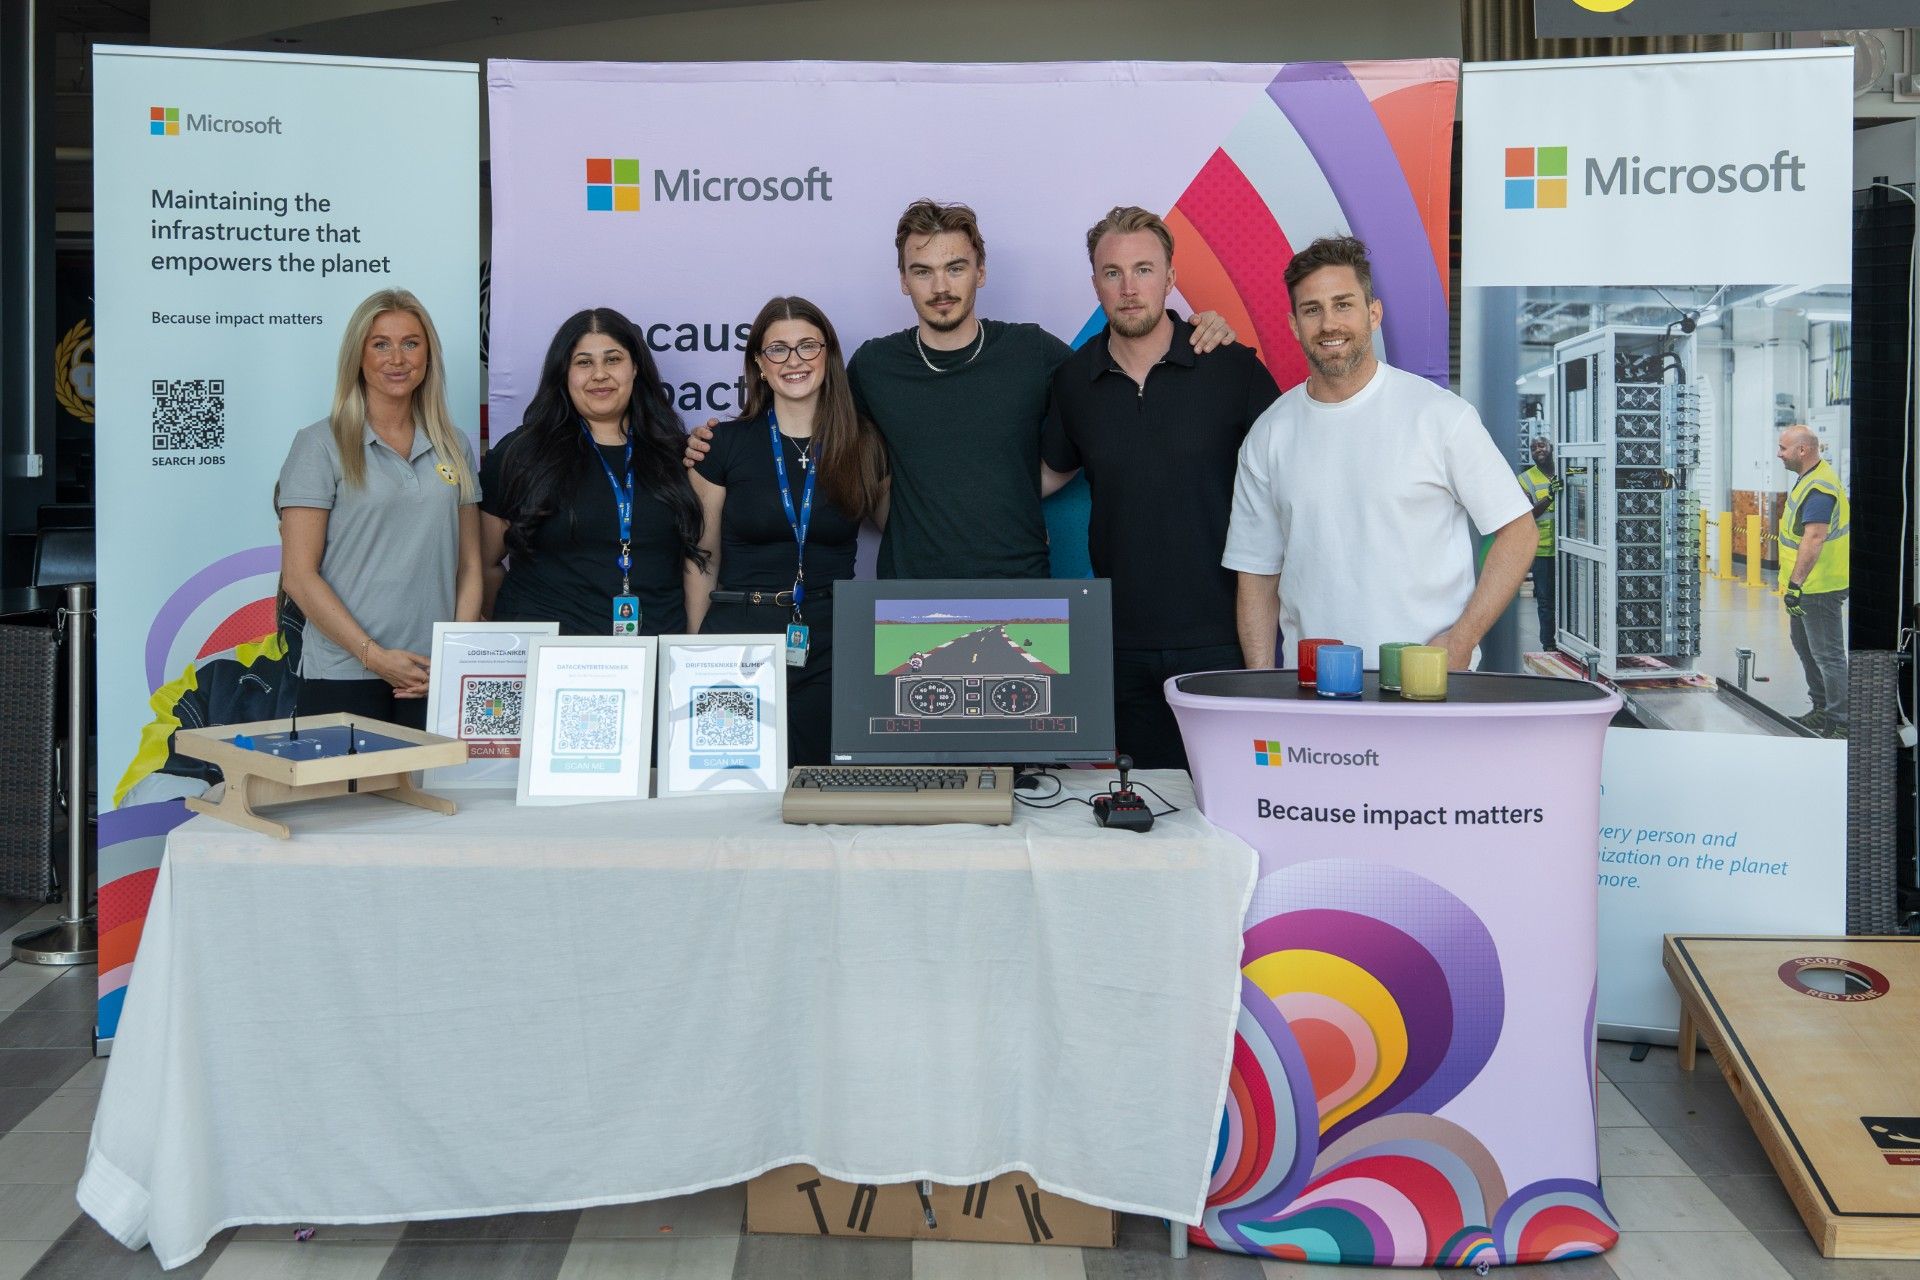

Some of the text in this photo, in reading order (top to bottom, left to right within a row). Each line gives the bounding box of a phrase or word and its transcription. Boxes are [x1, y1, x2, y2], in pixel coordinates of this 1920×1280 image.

[187, 113, 282, 135] Microsoft
[654, 166, 833, 202] Microsoft
[1585, 150, 1806, 196] Microsoft
[151, 189, 331, 217] Maintaining the
[151, 219, 361, 244] infrastructure that
[151, 252, 391, 277] empowers the planet
[152, 311, 323, 327] Because impact matters
[637, 322, 752, 353] caus
[152, 455, 226, 466] SEARCH JOBS
[470, 747, 511, 755] SCAN ME
[1287, 746, 1379, 766] Microsoft
[703, 758, 745, 767] SCAN ME
[1257, 798, 1544, 830] Because impact matters
[1636, 828, 1696, 845] person
[1702, 831, 1738, 848] and
[1667, 855, 1690, 869] on
[1696, 853, 1725, 871] the
[1729, 857, 1789, 876] planet
[1794, 957, 1850, 966] SCORE
[1806, 988, 1883, 1001] RED ZONE
